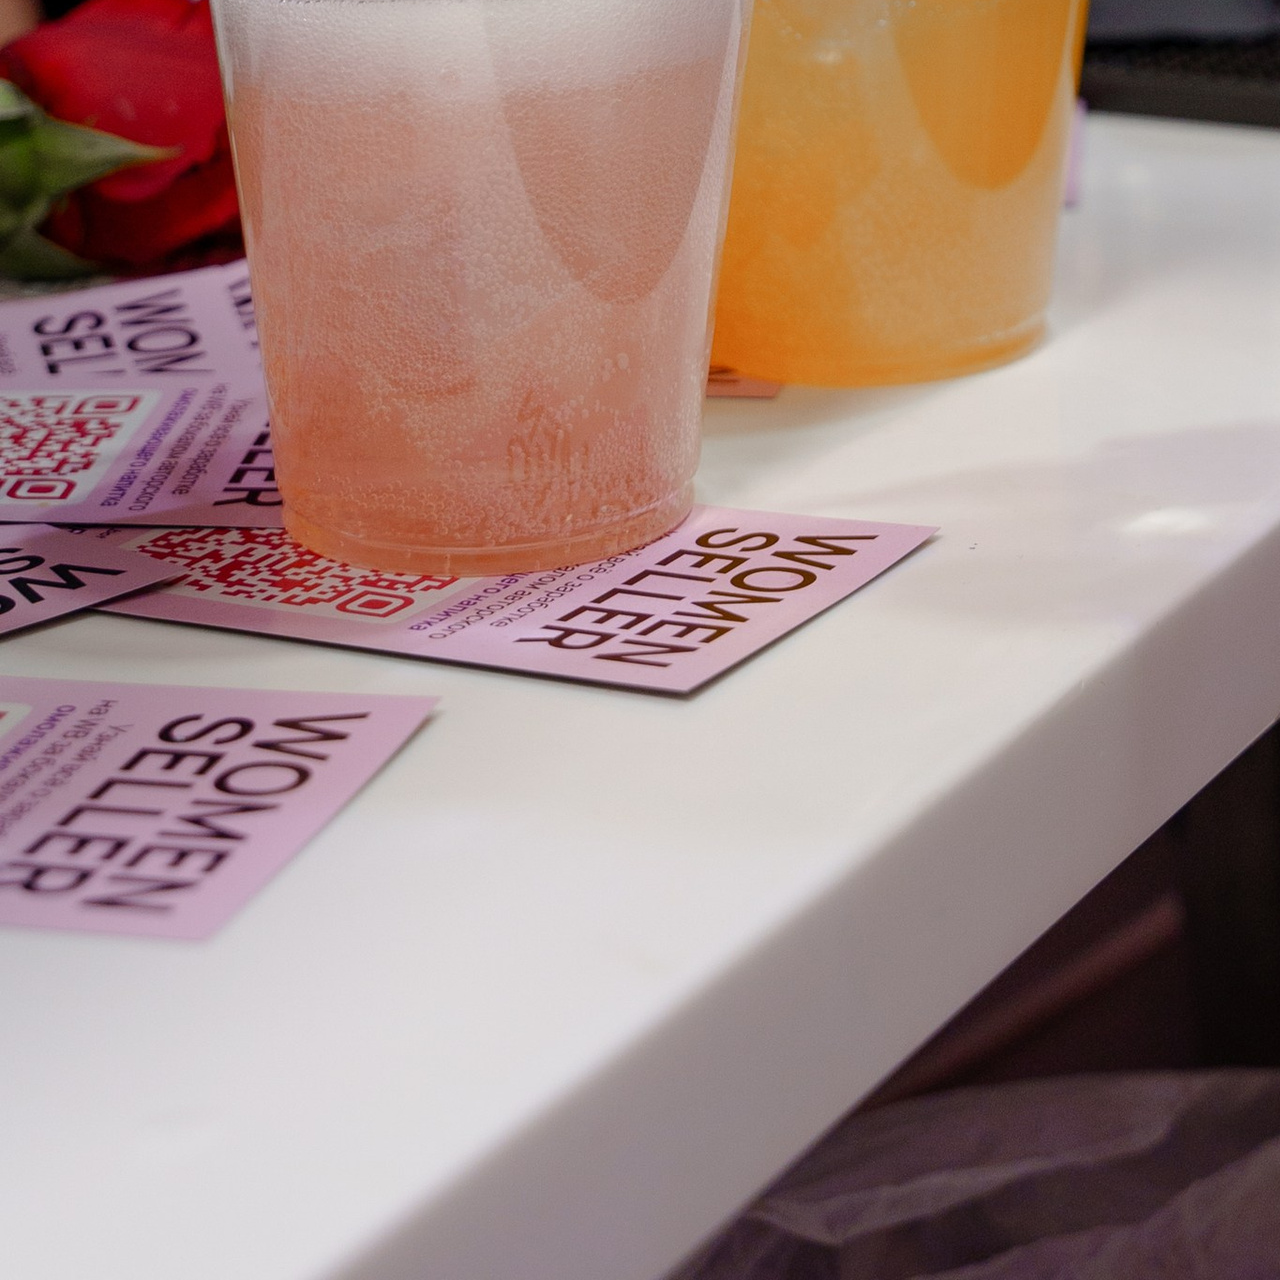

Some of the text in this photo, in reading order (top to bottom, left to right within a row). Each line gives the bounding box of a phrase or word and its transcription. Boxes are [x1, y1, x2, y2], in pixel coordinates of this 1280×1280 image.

[115, 289, 214, 374] WOM
[408, 594, 489, 631] напитка
[429, 590, 532, 639] авторского
[490, 581, 582, 627] заработке
[512, 527, 781, 650] SELLER
[594, 534, 879, 667] WOMEN
[0, 714, 255, 894] SELLER
[80, 711, 371, 912] WOMEN
